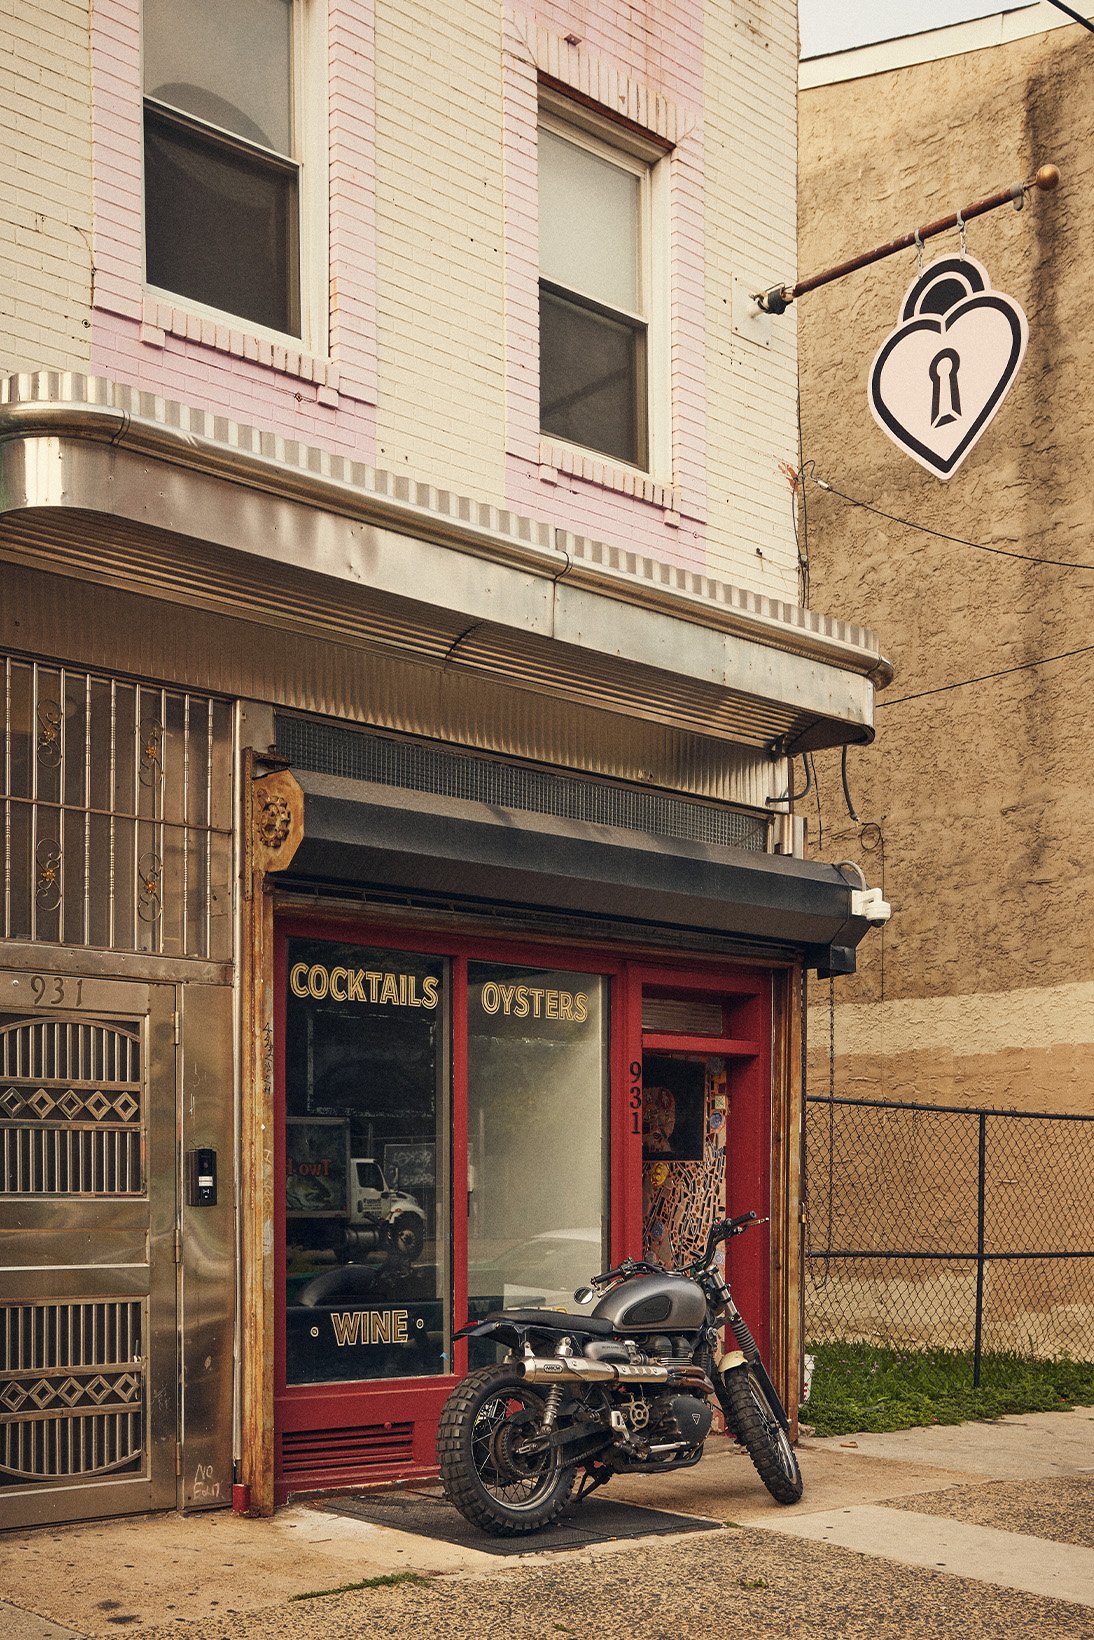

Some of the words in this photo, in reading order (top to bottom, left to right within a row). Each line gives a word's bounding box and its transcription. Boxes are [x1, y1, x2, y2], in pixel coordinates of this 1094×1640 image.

[30, 974, 84, 1007] 931
[290, 962, 439, 1009] COCKTAILS
[481, 981, 589, 1023] OYSTERS
[629, 1060, 642, 1135] 931
[331, 1310, 409, 1346] WINE
